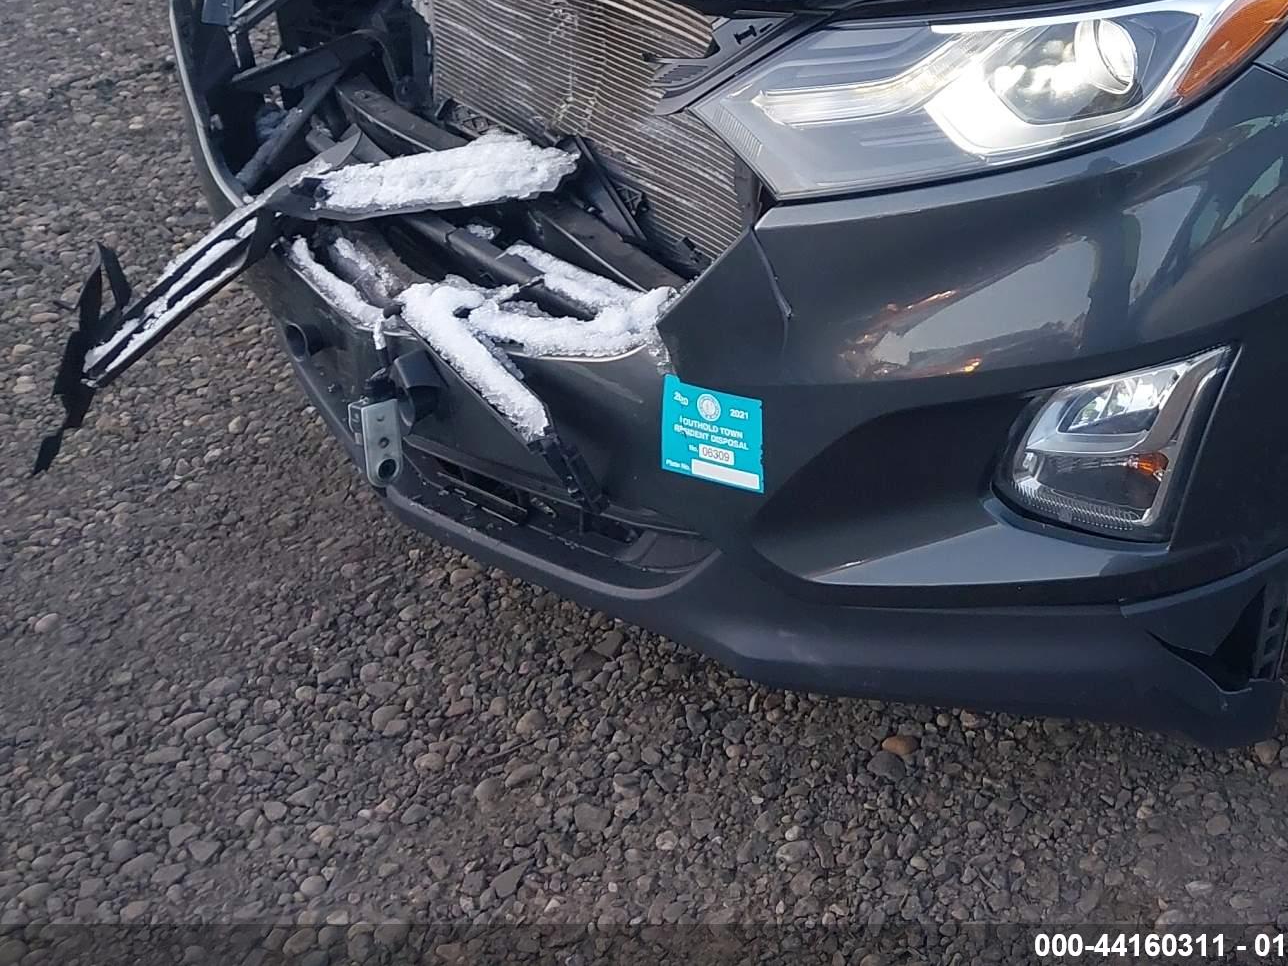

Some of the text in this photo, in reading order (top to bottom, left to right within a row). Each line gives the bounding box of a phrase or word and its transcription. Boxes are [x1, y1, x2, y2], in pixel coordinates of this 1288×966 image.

[729, 409, 749, 420] 2021
[720, 427, 743, 439] TOWN
[710, 435, 749, 451] DISPOSAL
[702, 446, 730, 462] 06309
